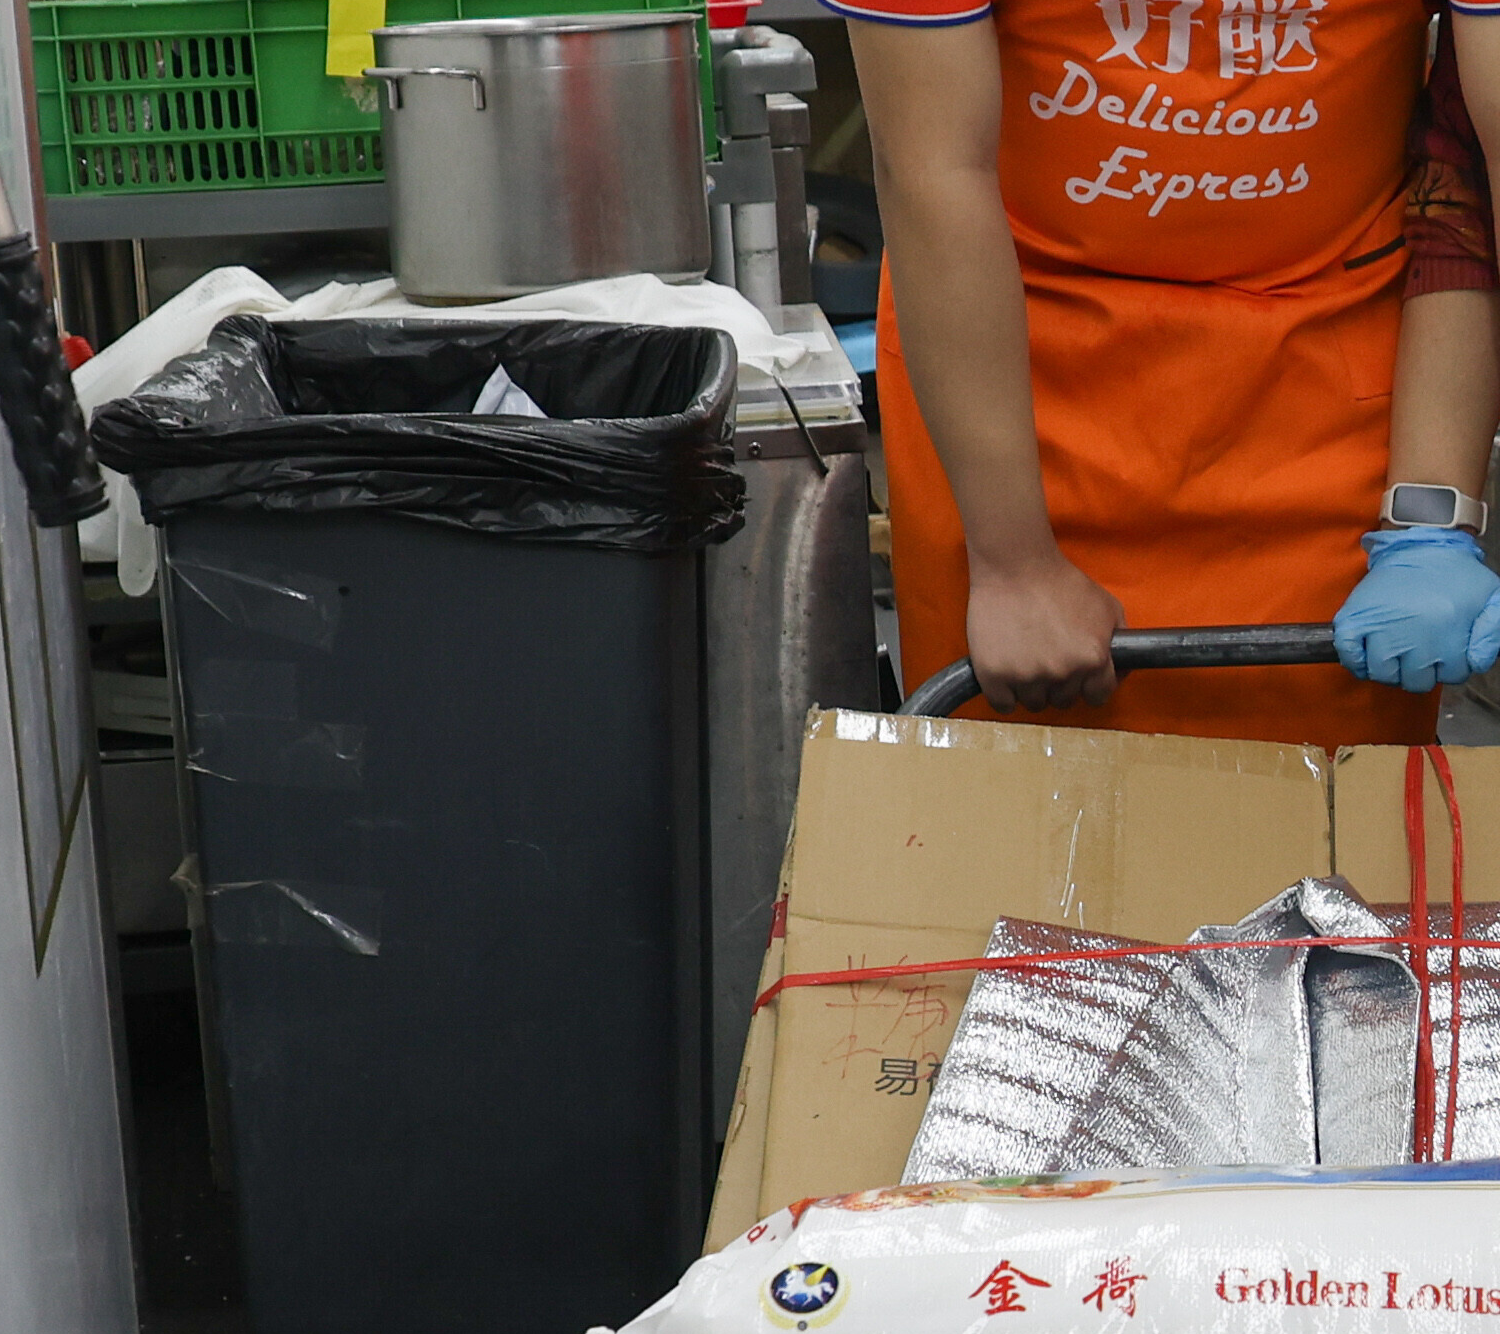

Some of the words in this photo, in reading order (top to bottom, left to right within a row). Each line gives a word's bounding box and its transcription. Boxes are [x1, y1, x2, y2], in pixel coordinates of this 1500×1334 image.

[1028, 59, 1320, 136] Delicious
[1065, 145, 1311, 218] Express
[968, 1256, 1149, 1319] 金荷
[1214, 1267, 1370, 1309] Golden
